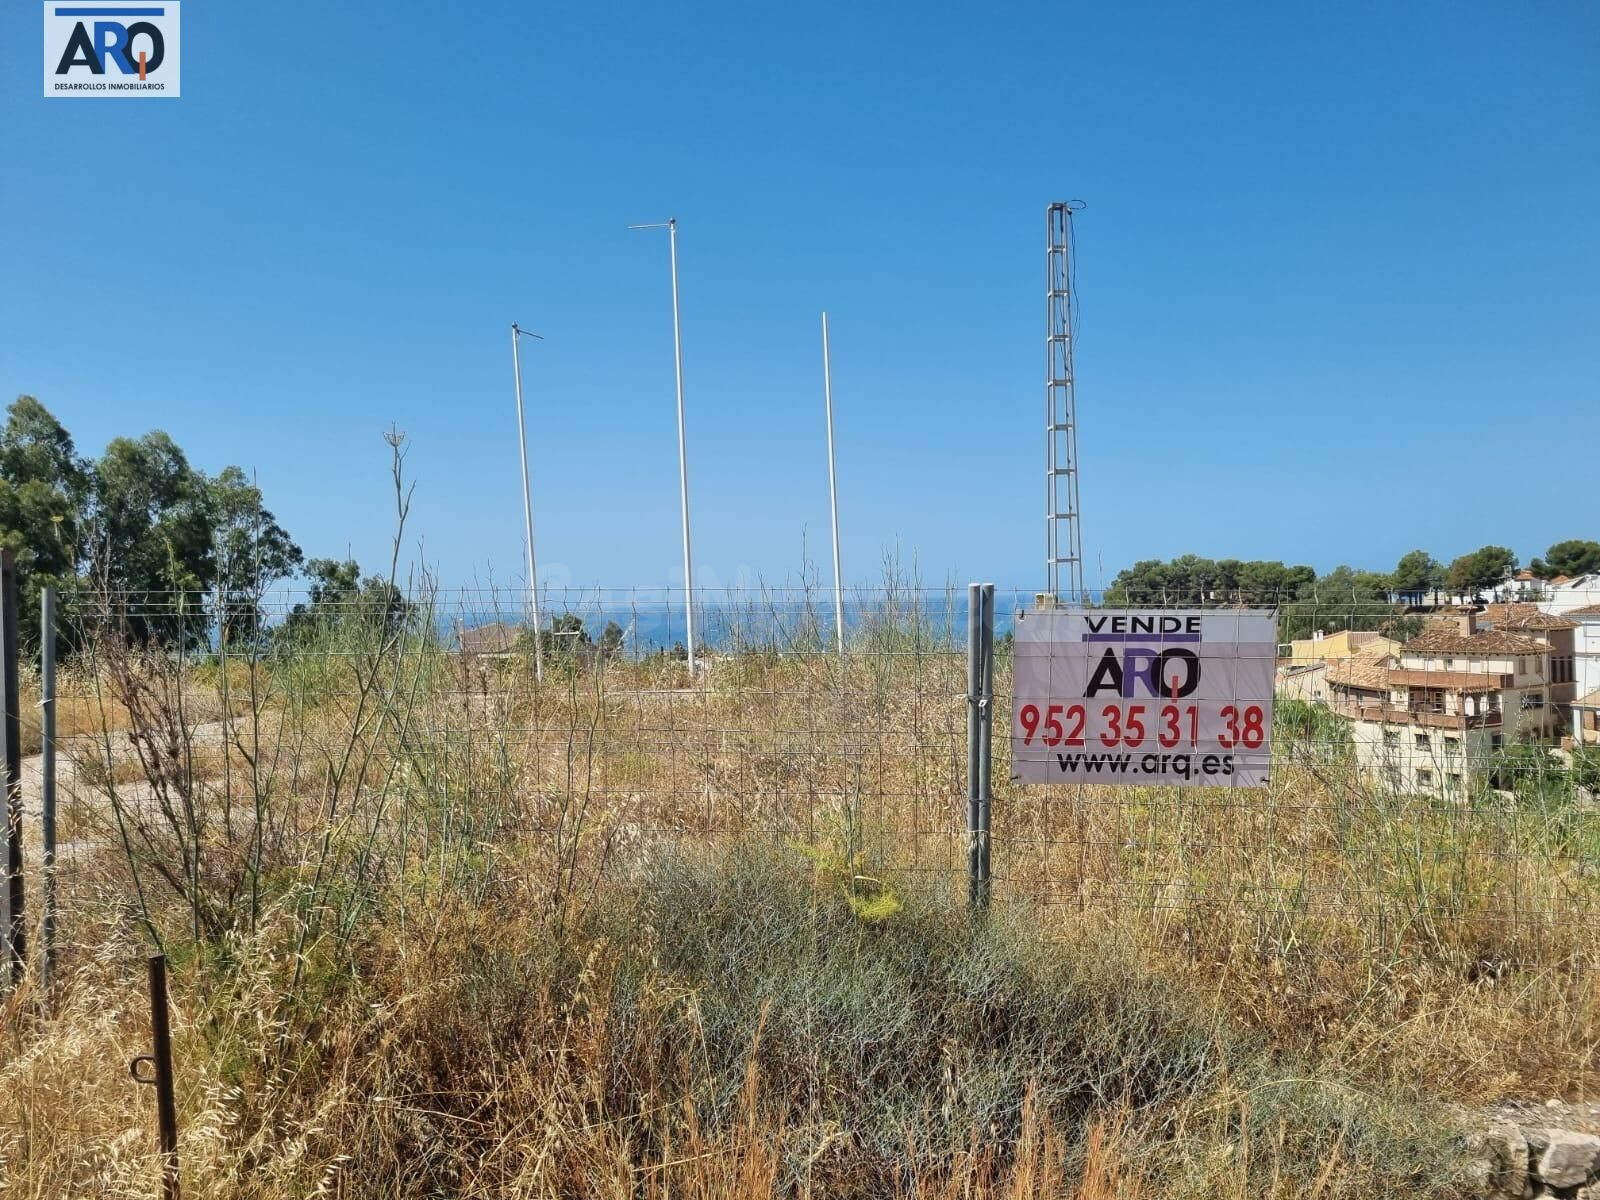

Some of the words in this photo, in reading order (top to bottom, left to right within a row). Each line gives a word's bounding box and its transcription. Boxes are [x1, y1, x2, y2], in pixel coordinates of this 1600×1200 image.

[1084, 616, 1201, 633] VENDE
[1082, 647, 1201, 703] ARQ
[1020, 704, 1086, 747] 952
[1100, 704, 1145, 748] 35
[1159, 705, 1199, 748] 31
[1218, 705, 1264, 749] 38
[1056, 753, 1235, 781] www.arq.es
